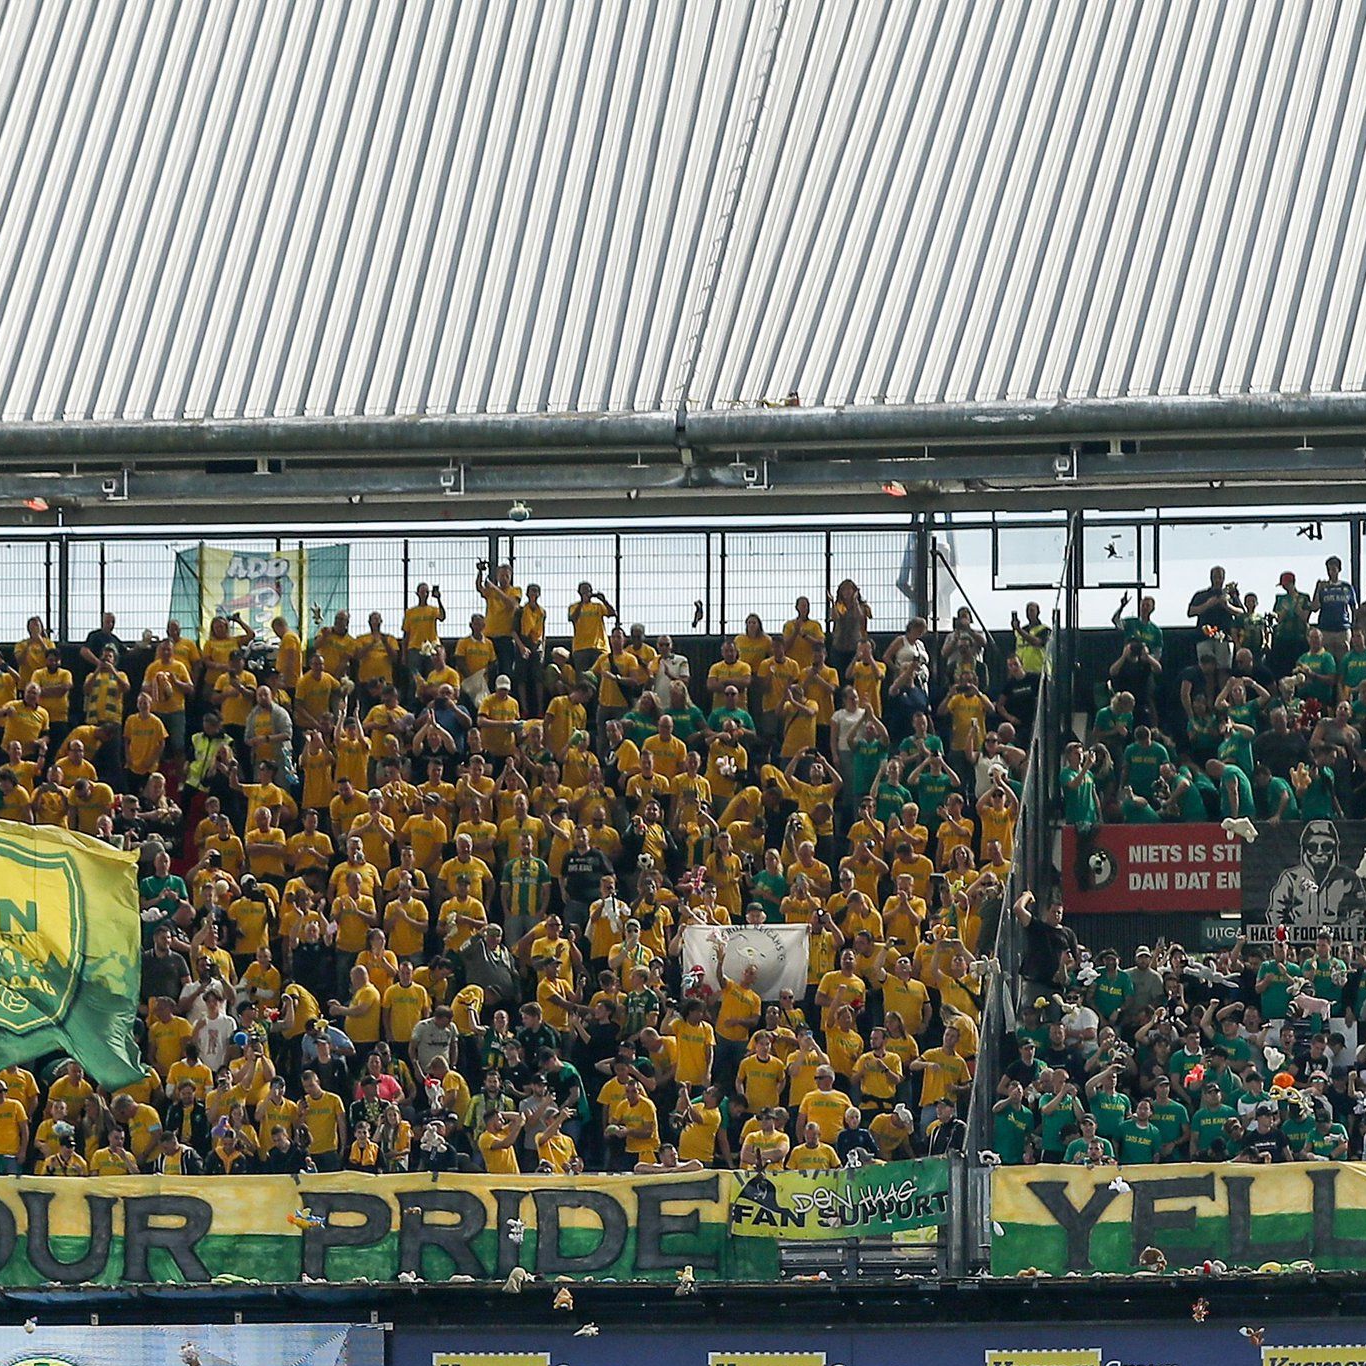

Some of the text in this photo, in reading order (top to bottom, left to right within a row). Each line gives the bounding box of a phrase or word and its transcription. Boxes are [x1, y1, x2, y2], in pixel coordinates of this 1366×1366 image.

[1129, 844, 1182, 863] NIETS
[1188, 844, 1202, 863] IS
[1129, 872, 1168, 890] DAN
[1175, 872, 1210, 889] DAT
[735, 1194, 949, 1228] FAN SUPPORT
[299, 1177, 723, 1277] PRIDE
